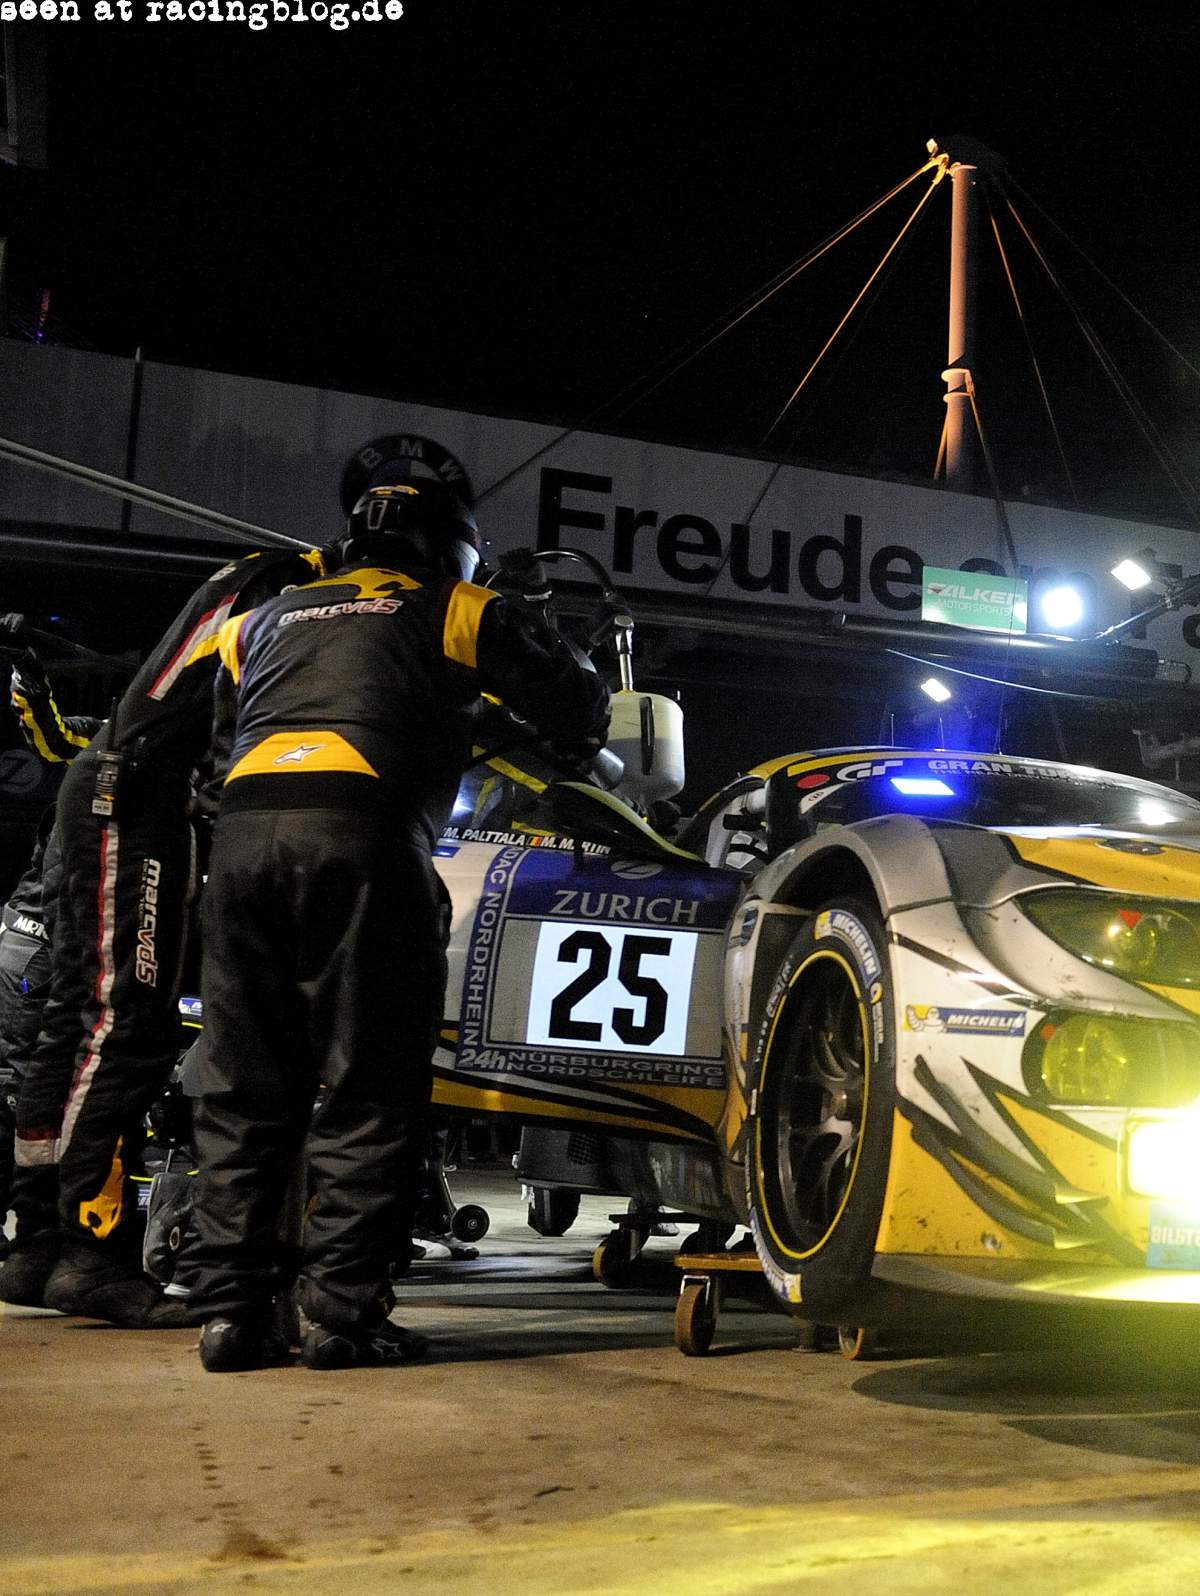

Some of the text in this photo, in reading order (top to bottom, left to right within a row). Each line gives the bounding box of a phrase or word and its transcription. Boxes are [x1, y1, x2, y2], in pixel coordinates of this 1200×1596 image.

[537, 466, 924, 612] Freude
[928, 759, 1012, 774] GRAN
[461, 829, 526, 846] PALTTALA
[549, 889, 700, 925] ZURICH
[464, 892, 500, 1047] NORDRHEIN
[548, 930, 673, 1046] 25
[946, 1014, 1025, 1029] MICHELIN
[458, 1050, 724, 1077] 24h NÜRBURGRING
[507, 1062, 723, 1087] NORDSCHLEIFE
